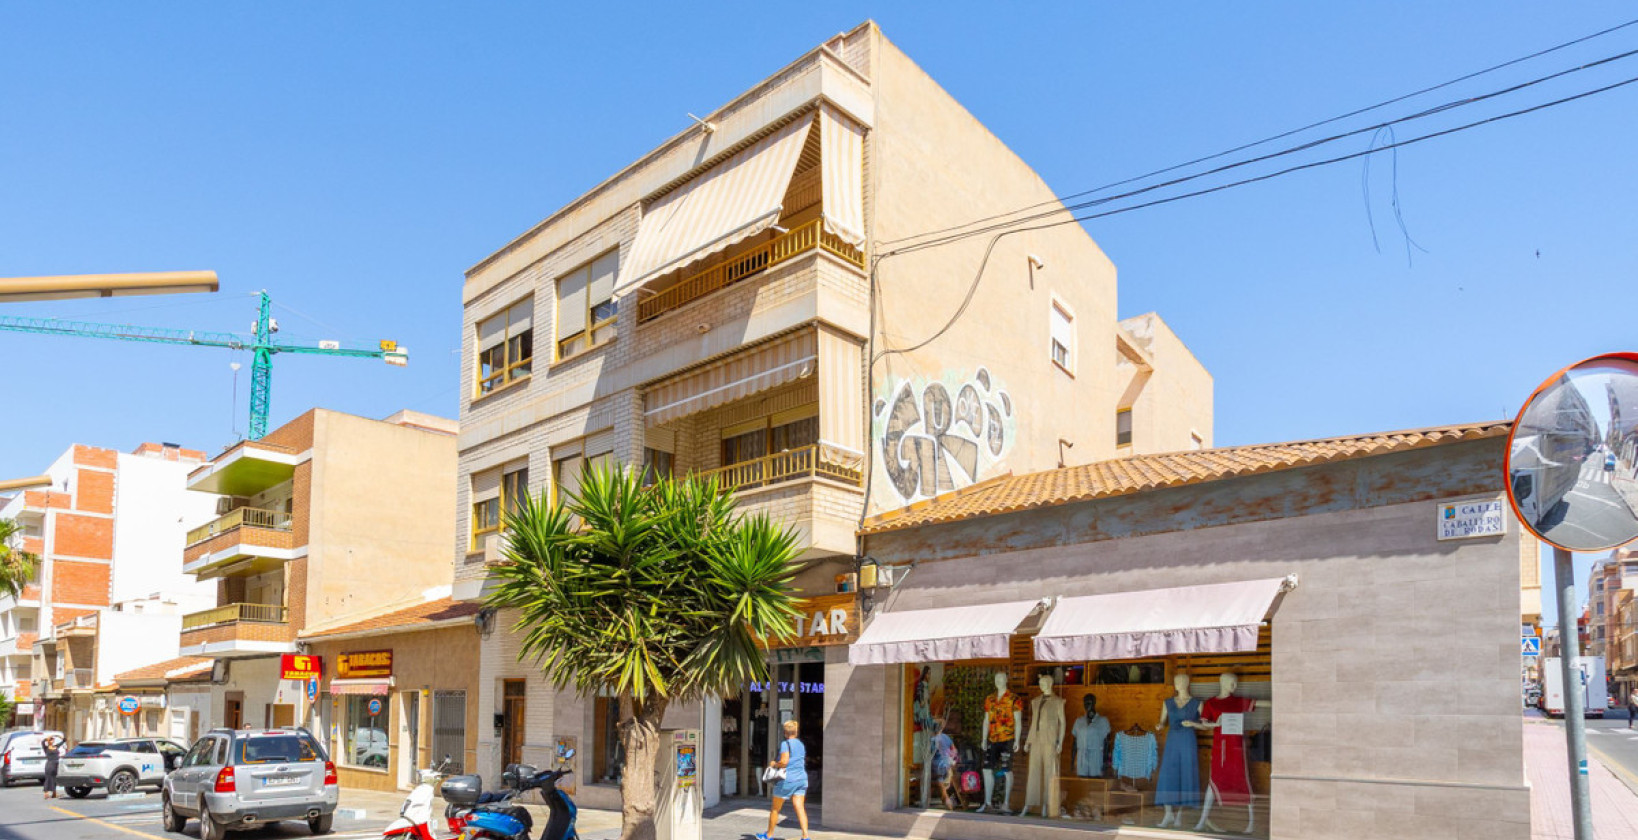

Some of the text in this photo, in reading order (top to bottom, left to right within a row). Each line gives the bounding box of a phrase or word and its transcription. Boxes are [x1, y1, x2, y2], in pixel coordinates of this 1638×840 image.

[1461, 503, 1502, 514] CALLE
[1464, 524, 1498, 535] RODAS
[778, 608, 848, 638] TAR
